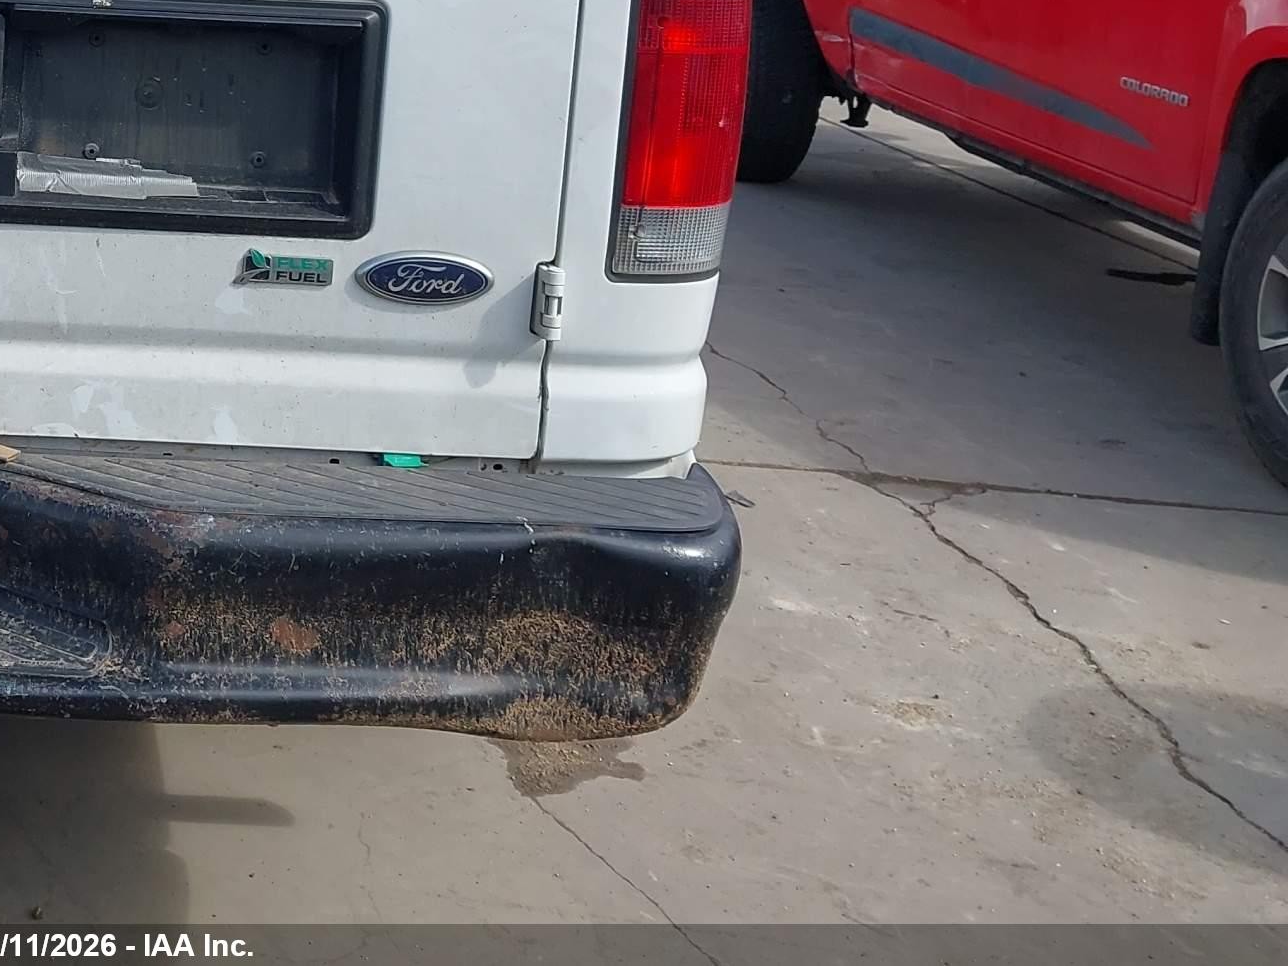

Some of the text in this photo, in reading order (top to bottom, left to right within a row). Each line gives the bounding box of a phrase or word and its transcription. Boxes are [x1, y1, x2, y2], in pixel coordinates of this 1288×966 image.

[1120, 76, 1189, 107] COLORADO
[275, 256, 328, 270] FLEX
[275, 270, 328, 283] FUEL
[387, 263, 465, 294] Ford
